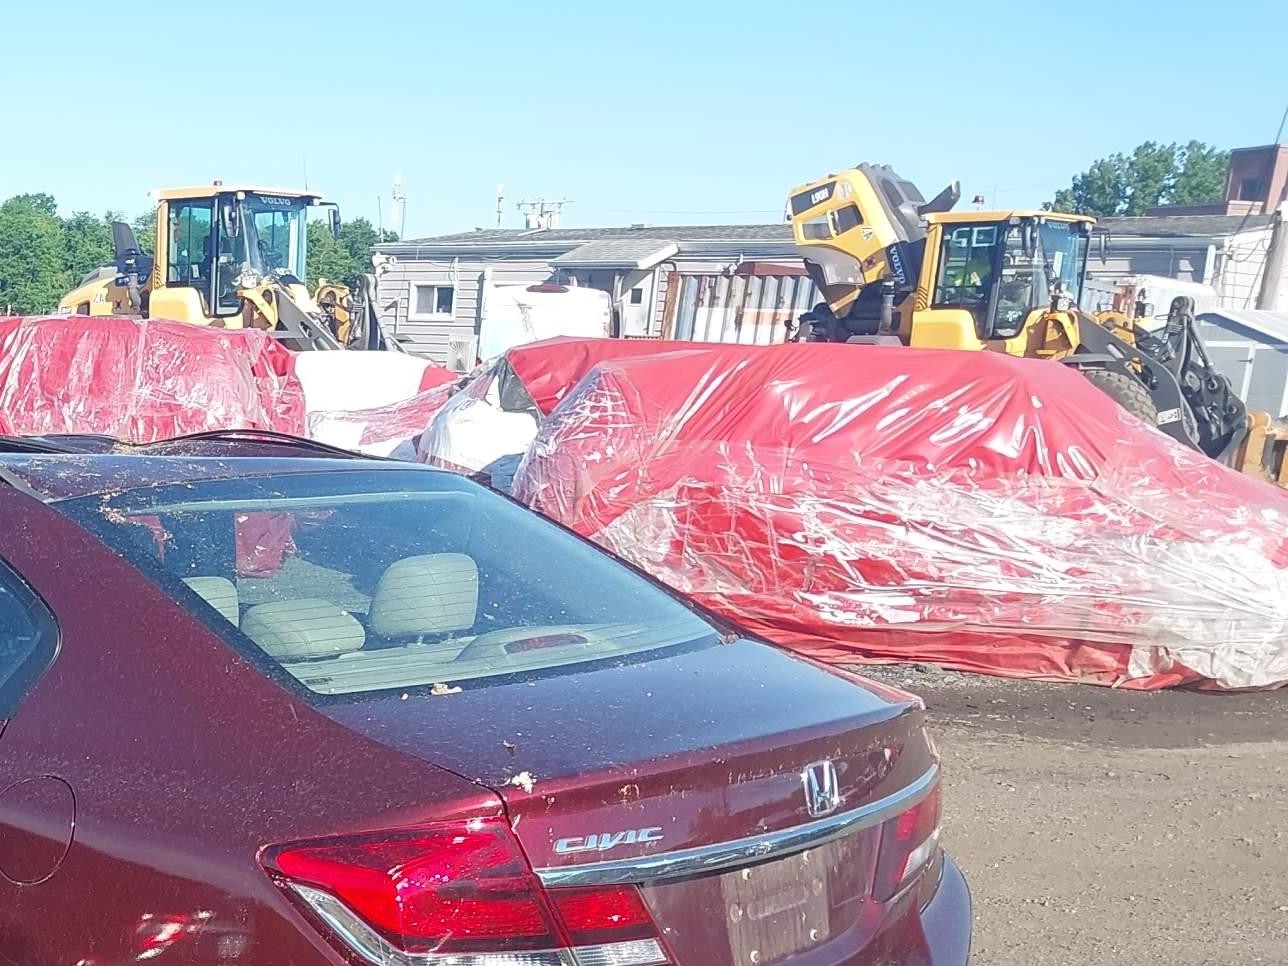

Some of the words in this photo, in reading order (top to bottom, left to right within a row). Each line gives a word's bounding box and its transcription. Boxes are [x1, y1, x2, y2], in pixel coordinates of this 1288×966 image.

[260, 196, 291, 206] VOLVO
[889, 246, 906, 284] VOLVO
[554, 827, 664, 854] CIVIC
